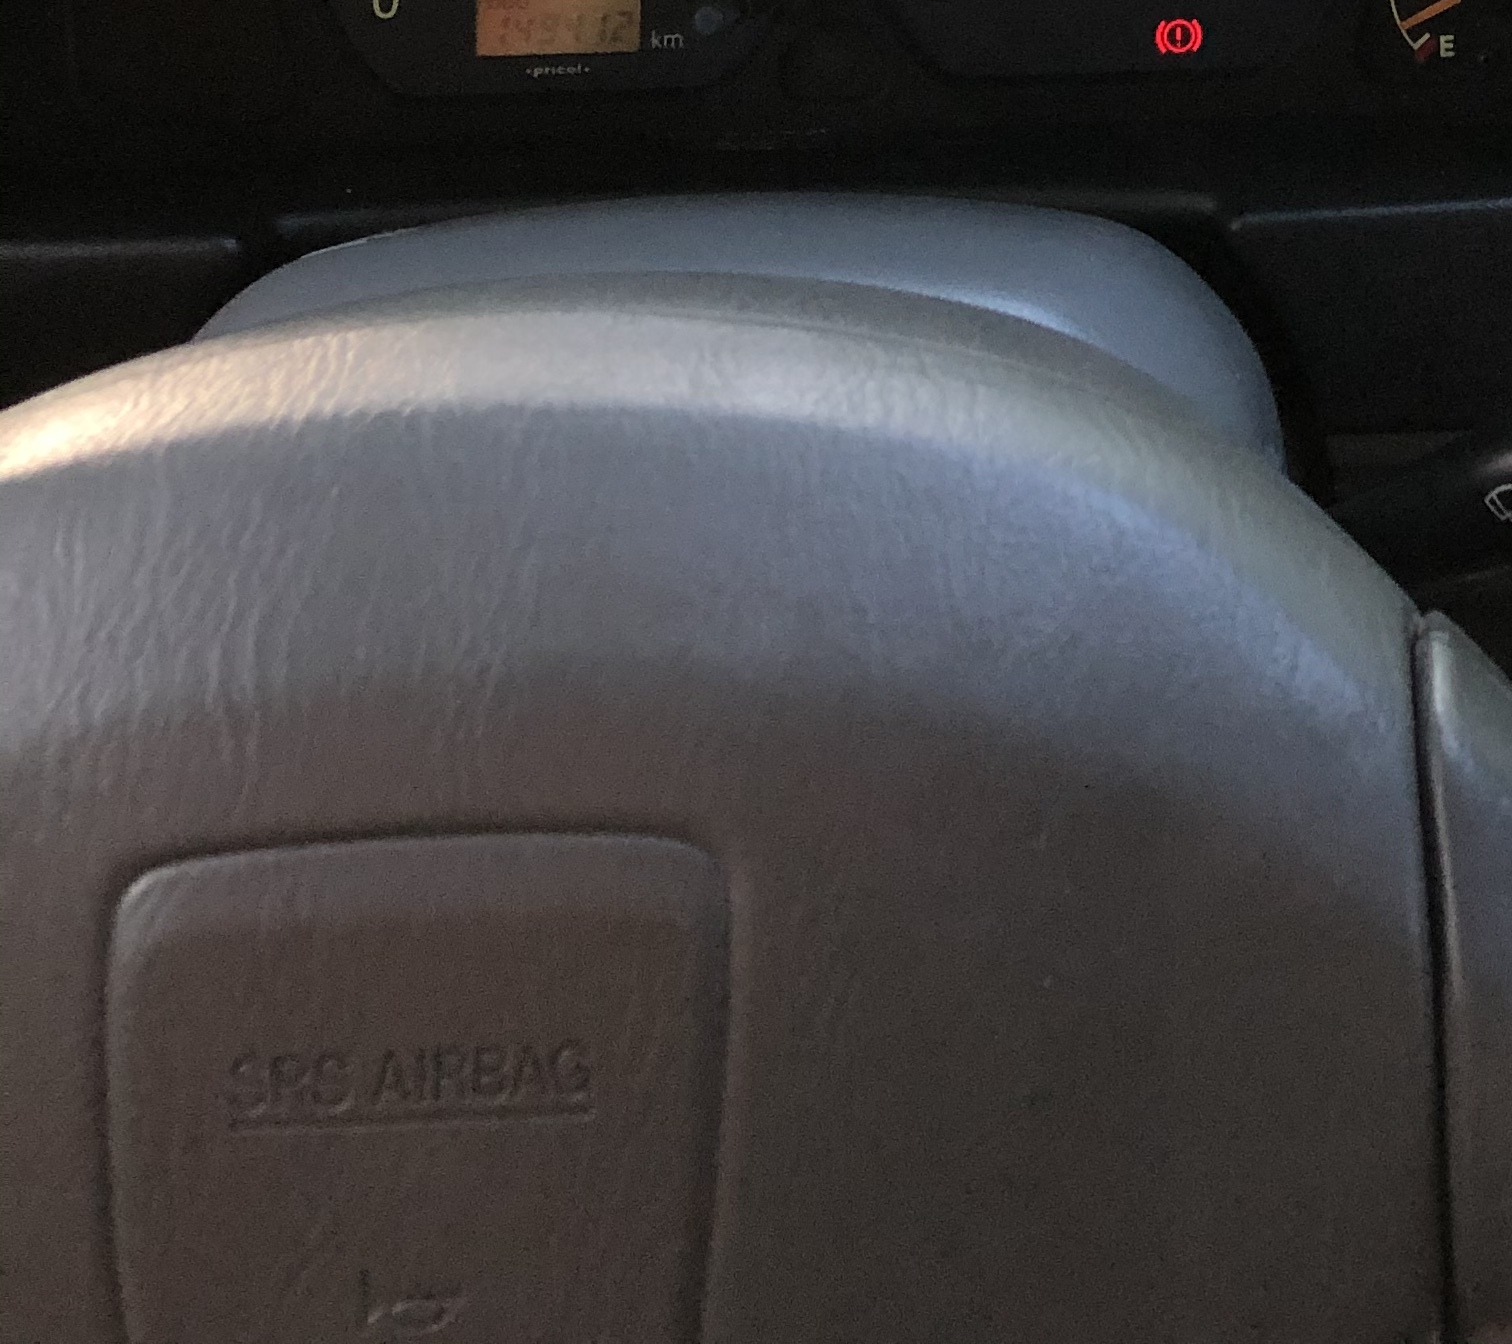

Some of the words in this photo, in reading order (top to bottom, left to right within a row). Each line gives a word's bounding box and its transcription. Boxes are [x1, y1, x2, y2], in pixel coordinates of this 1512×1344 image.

[650, 30, 684, 49] km
[1439, 34, 1455, 58] E
[370, 1038, 593, 1104] AIRBAG
